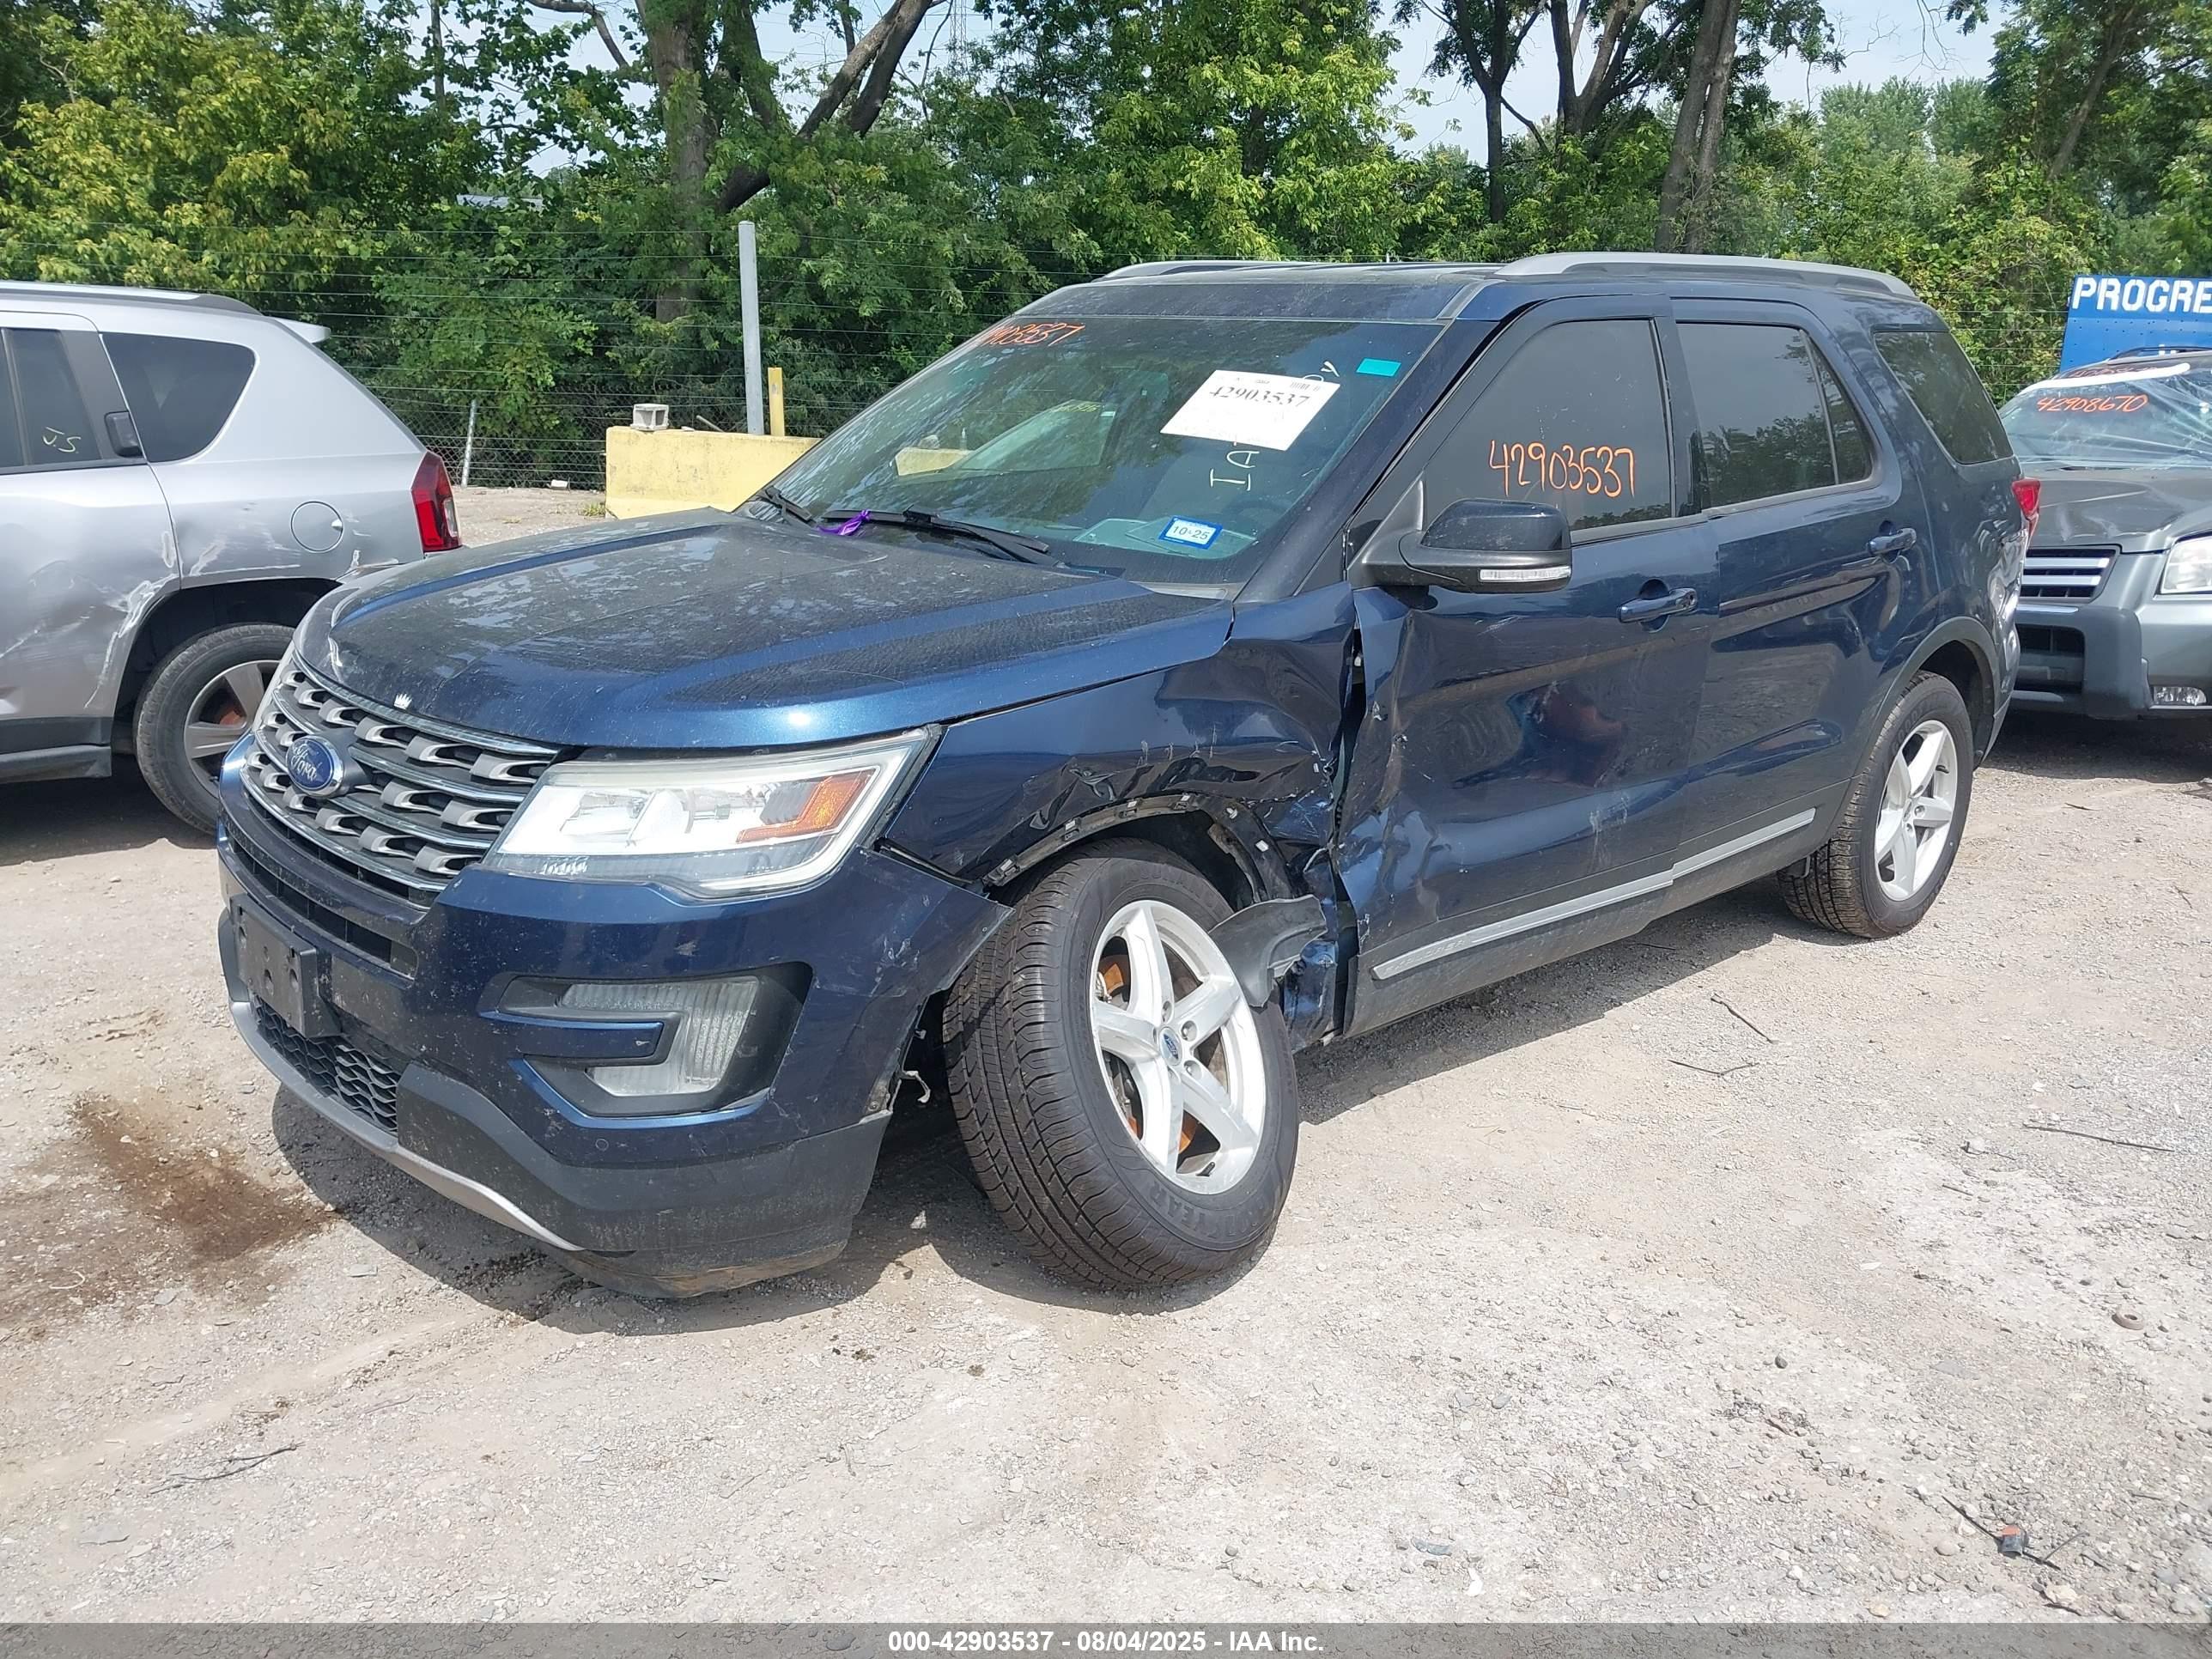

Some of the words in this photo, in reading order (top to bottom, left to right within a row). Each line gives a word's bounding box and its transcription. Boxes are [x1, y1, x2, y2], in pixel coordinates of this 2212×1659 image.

[1209, 386, 1311, 407] 42903537
[2036, 393, 2148, 413] 42908670
[1488, 439, 1636, 499] 42903537
[290, 740, 324, 781] Ford
